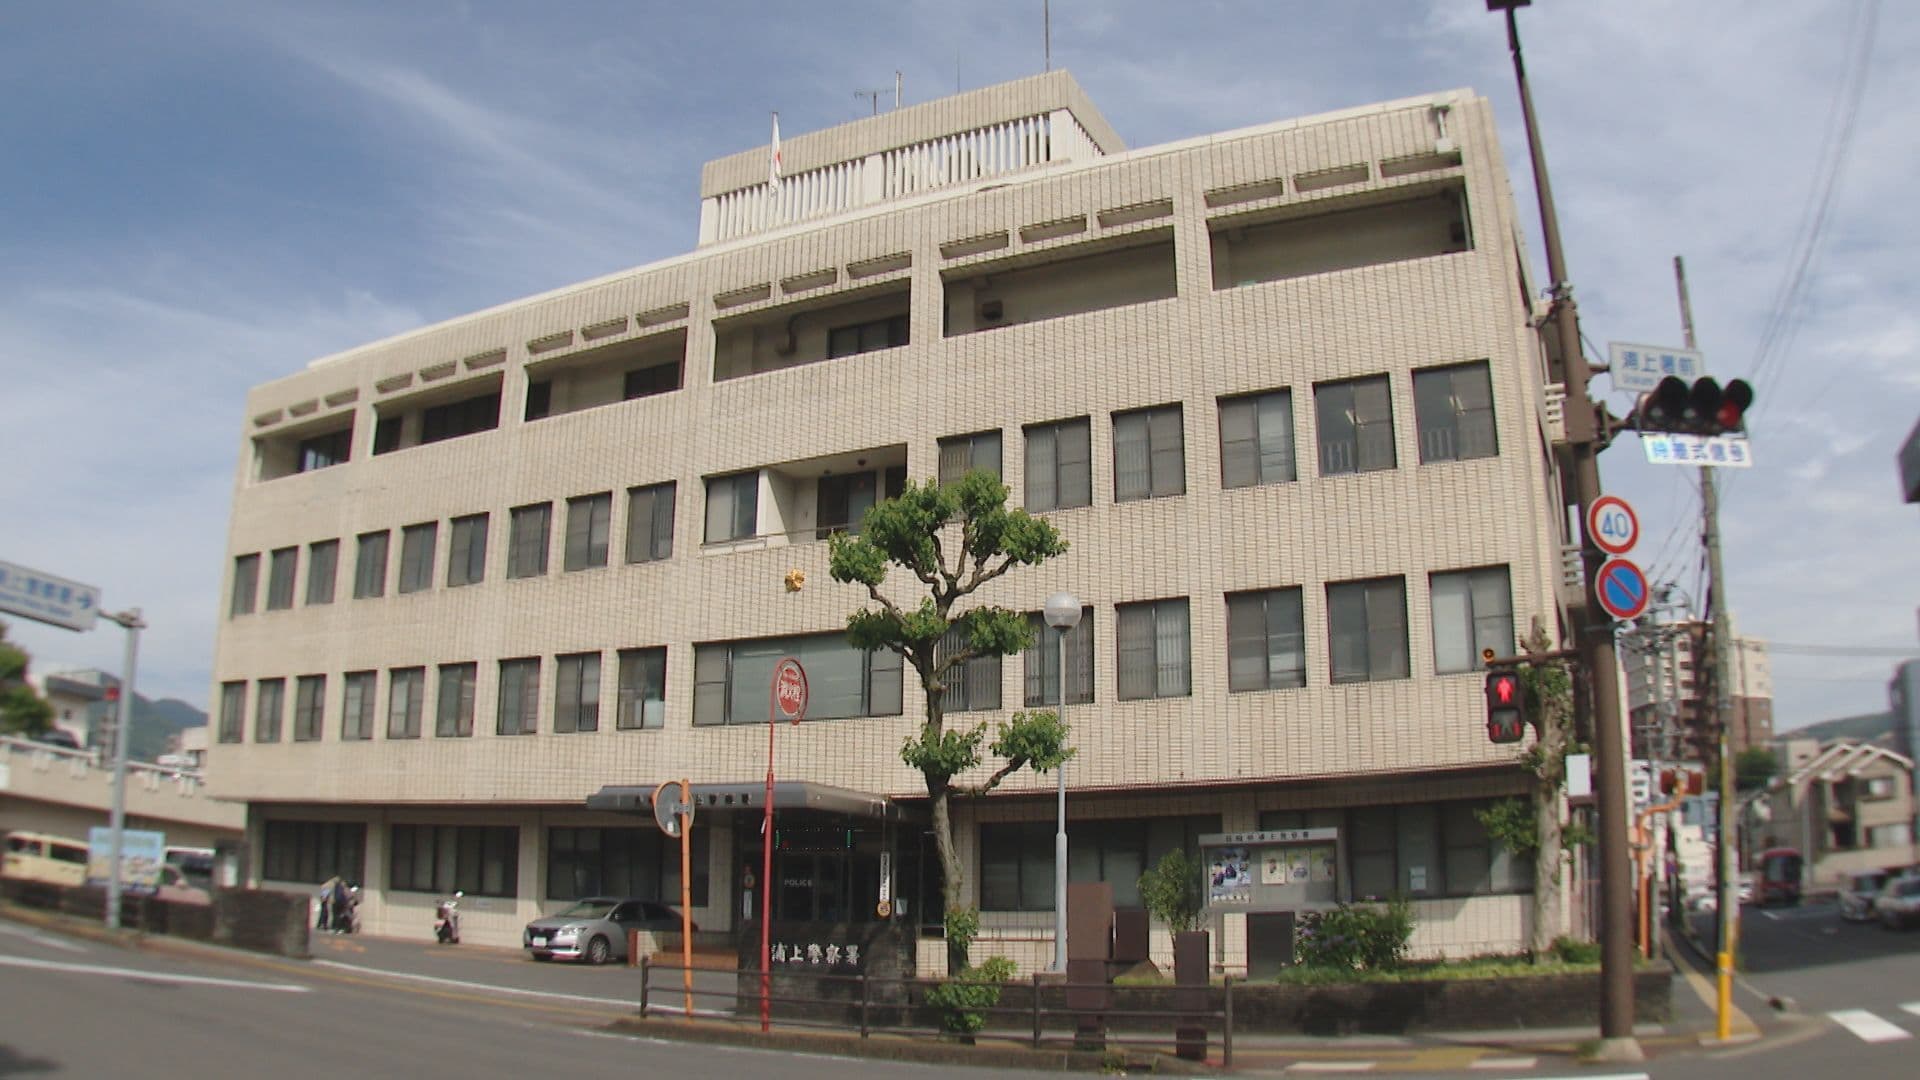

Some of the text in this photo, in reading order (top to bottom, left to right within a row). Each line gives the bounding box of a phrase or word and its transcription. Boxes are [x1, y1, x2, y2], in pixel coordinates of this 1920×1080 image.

[1601, 511, 1630, 539] 40
[784, 879, 813, 888] POLICE
[771, 942, 860, 966] 浦上警察署
